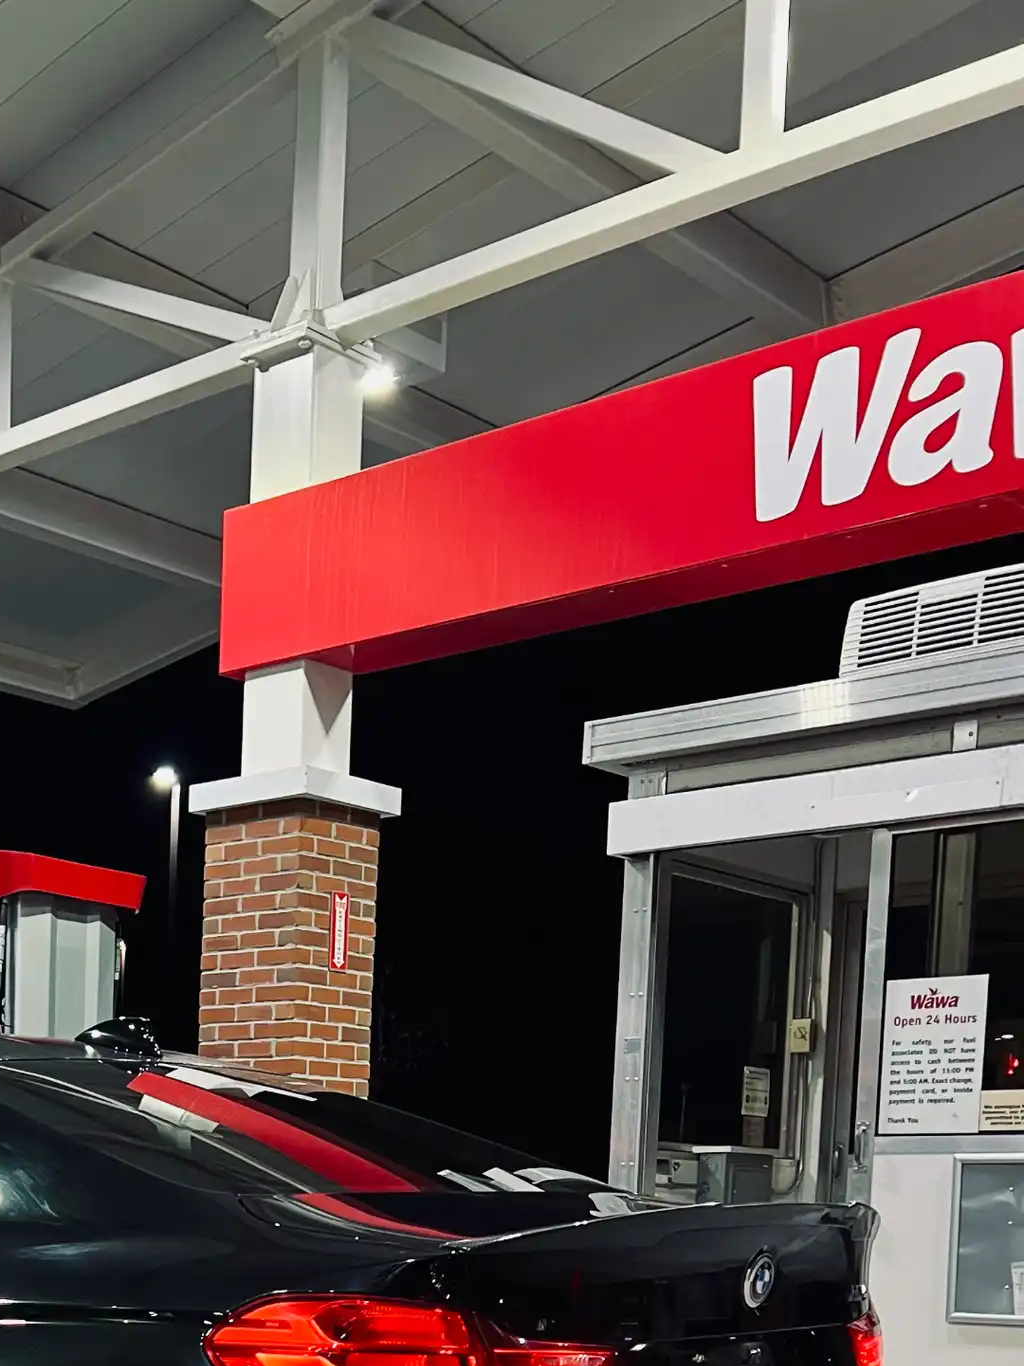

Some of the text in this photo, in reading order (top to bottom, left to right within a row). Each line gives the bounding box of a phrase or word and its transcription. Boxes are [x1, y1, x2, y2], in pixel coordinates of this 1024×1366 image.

[753, 327, 1024, 522] Wa
[910, 994, 959, 1010] Wawa
[894, 1013, 977, 1028] Open 24 Hours
